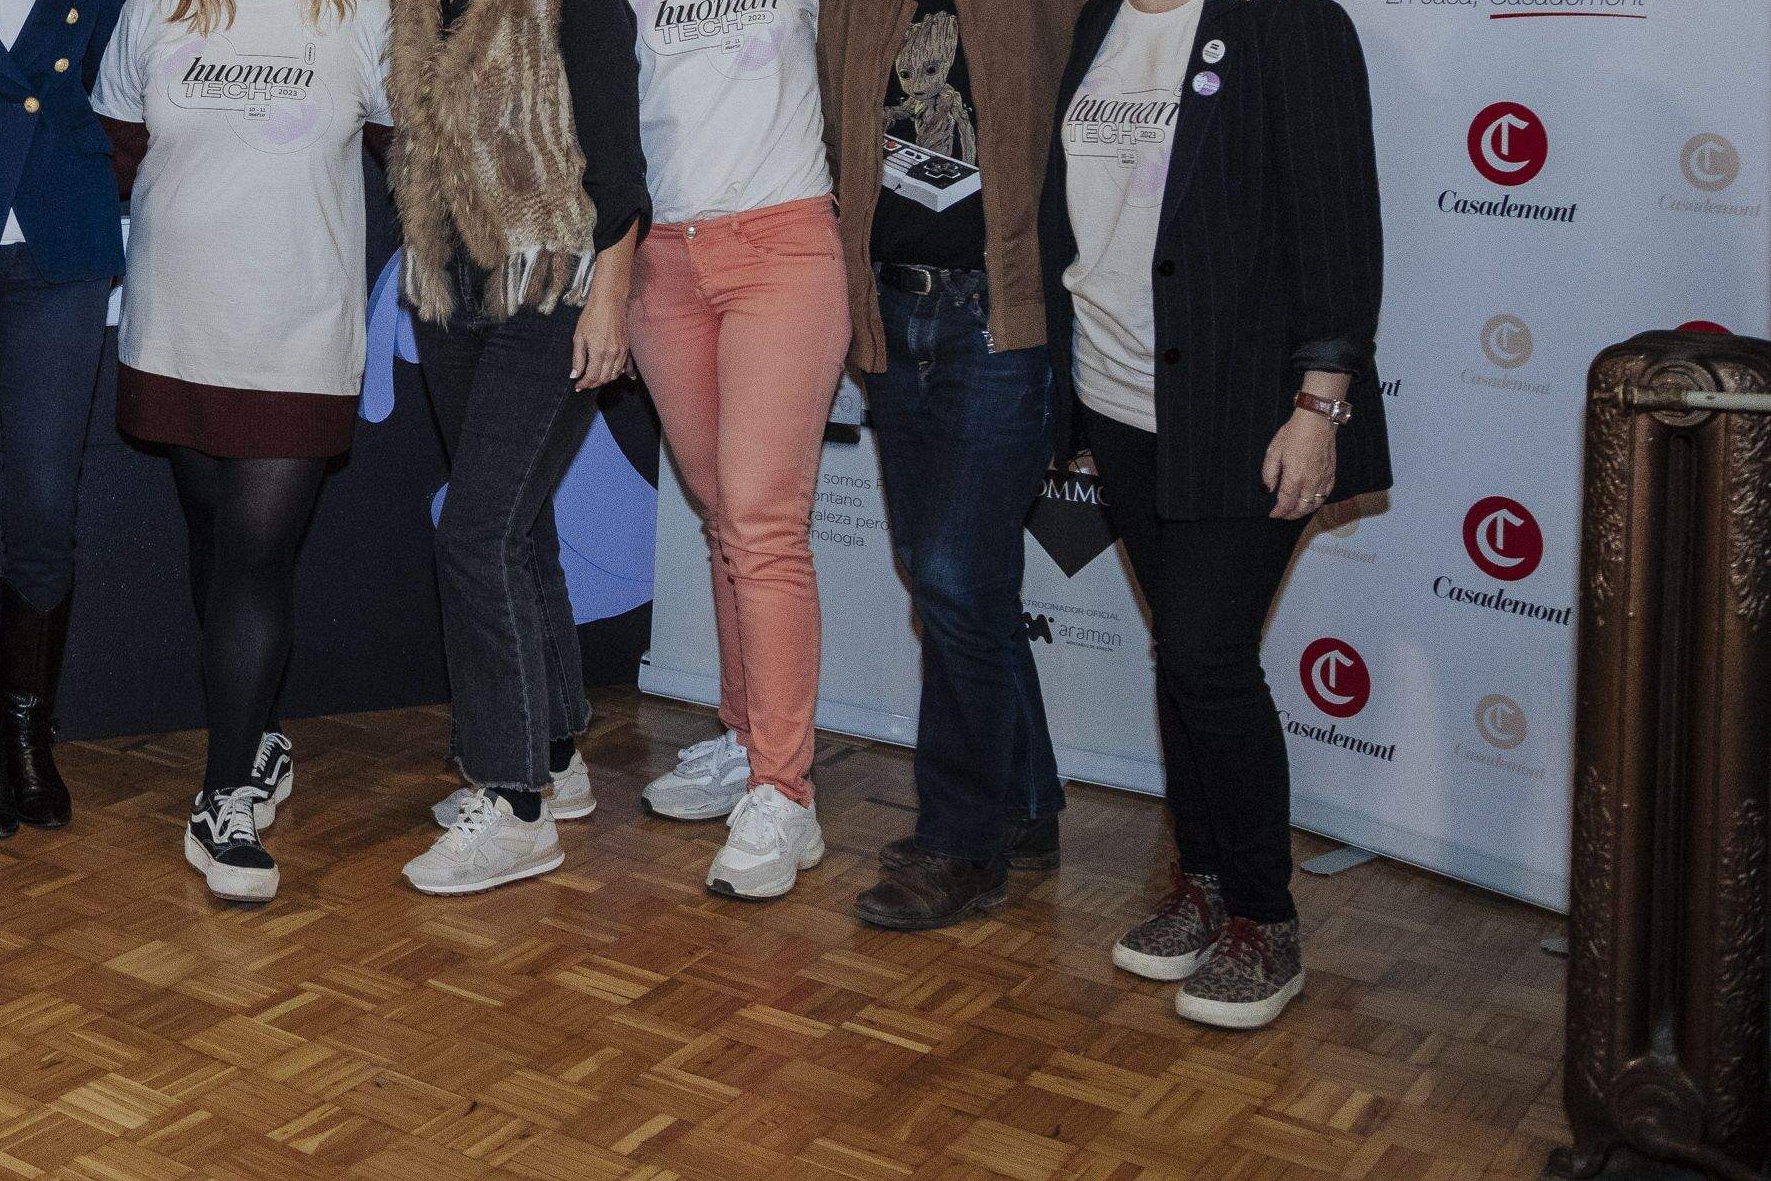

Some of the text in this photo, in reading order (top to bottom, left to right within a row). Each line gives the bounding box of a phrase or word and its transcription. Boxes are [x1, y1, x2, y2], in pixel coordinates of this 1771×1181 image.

[655, 11, 743, 45] TECH
[748, 14, 766, 22] 2023
[182, 55, 314, 87] huoman
[182, 79, 272, 100] TECH
[278, 88, 298, 97] 2023
[1068, 94, 1179, 126] huoman
[1067, 120, 1137, 144] TECH
[1139, 131, 1156, 139] 2023
[1437, 189, 1578, 223] Casademont
[823, 473, 871, 489] somos
[856, 516, 890, 530] pero
[1433, 575, 1573, 626] Casademont
[1059, 624, 1122, 647] aramon
[1277, 709, 1396, 762] Casademont
